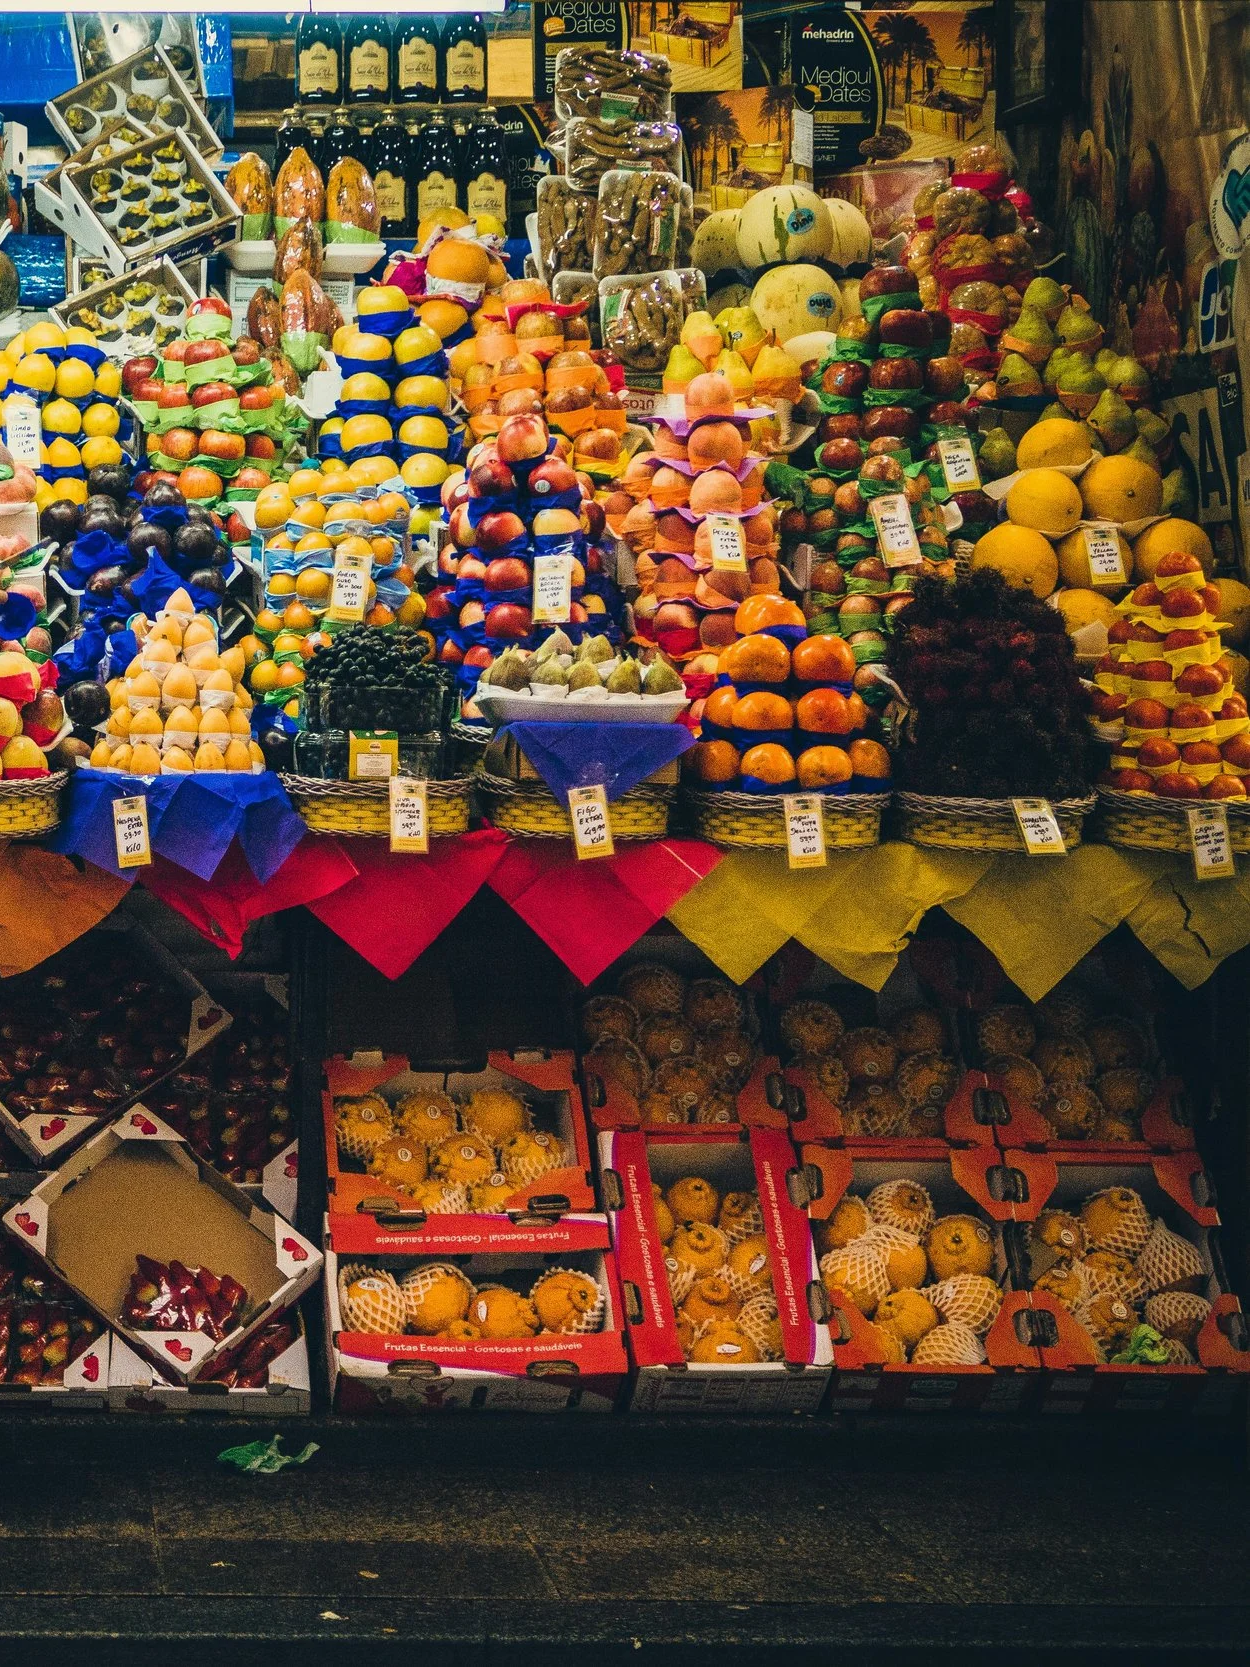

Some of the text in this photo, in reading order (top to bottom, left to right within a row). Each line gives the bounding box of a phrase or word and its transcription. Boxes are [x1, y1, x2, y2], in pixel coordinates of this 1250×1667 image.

[562, 16, 616, 34] Dates
[802, 28, 854, 39] mehadrin
[801, 66, 872, 88] Medjoul
[819, 85, 871, 103] Dates
[576, 805, 597, 817] FIGO
[579, 813, 603, 825] EXTRA
[627, 1164, 639, 1193] Frutas
[762, 1160, 779, 1202] saudáveis
[631, 1193, 648, 1233] Essencial
[432, 1234, 482, 1243] Gostosas
[489, 1232, 536, 1243] Essencial
[537, 1232, 570, 1241] Frutas
[772, 1207, 787, 1251] Gostosas
[639, 1238, 654, 1281] Gostosas
[778, 1256, 796, 1297] Essencial
[649, 1286, 666, 1329] saudáveis
[786, 1297, 800, 1327] Frutas
[384, 1342, 419, 1352] Frutas
[420, 1343, 467, 1353] Essencial
[474, 1344, 524, 1354] Gostosas
[533, 1341, 583, 1353] saudáveis
